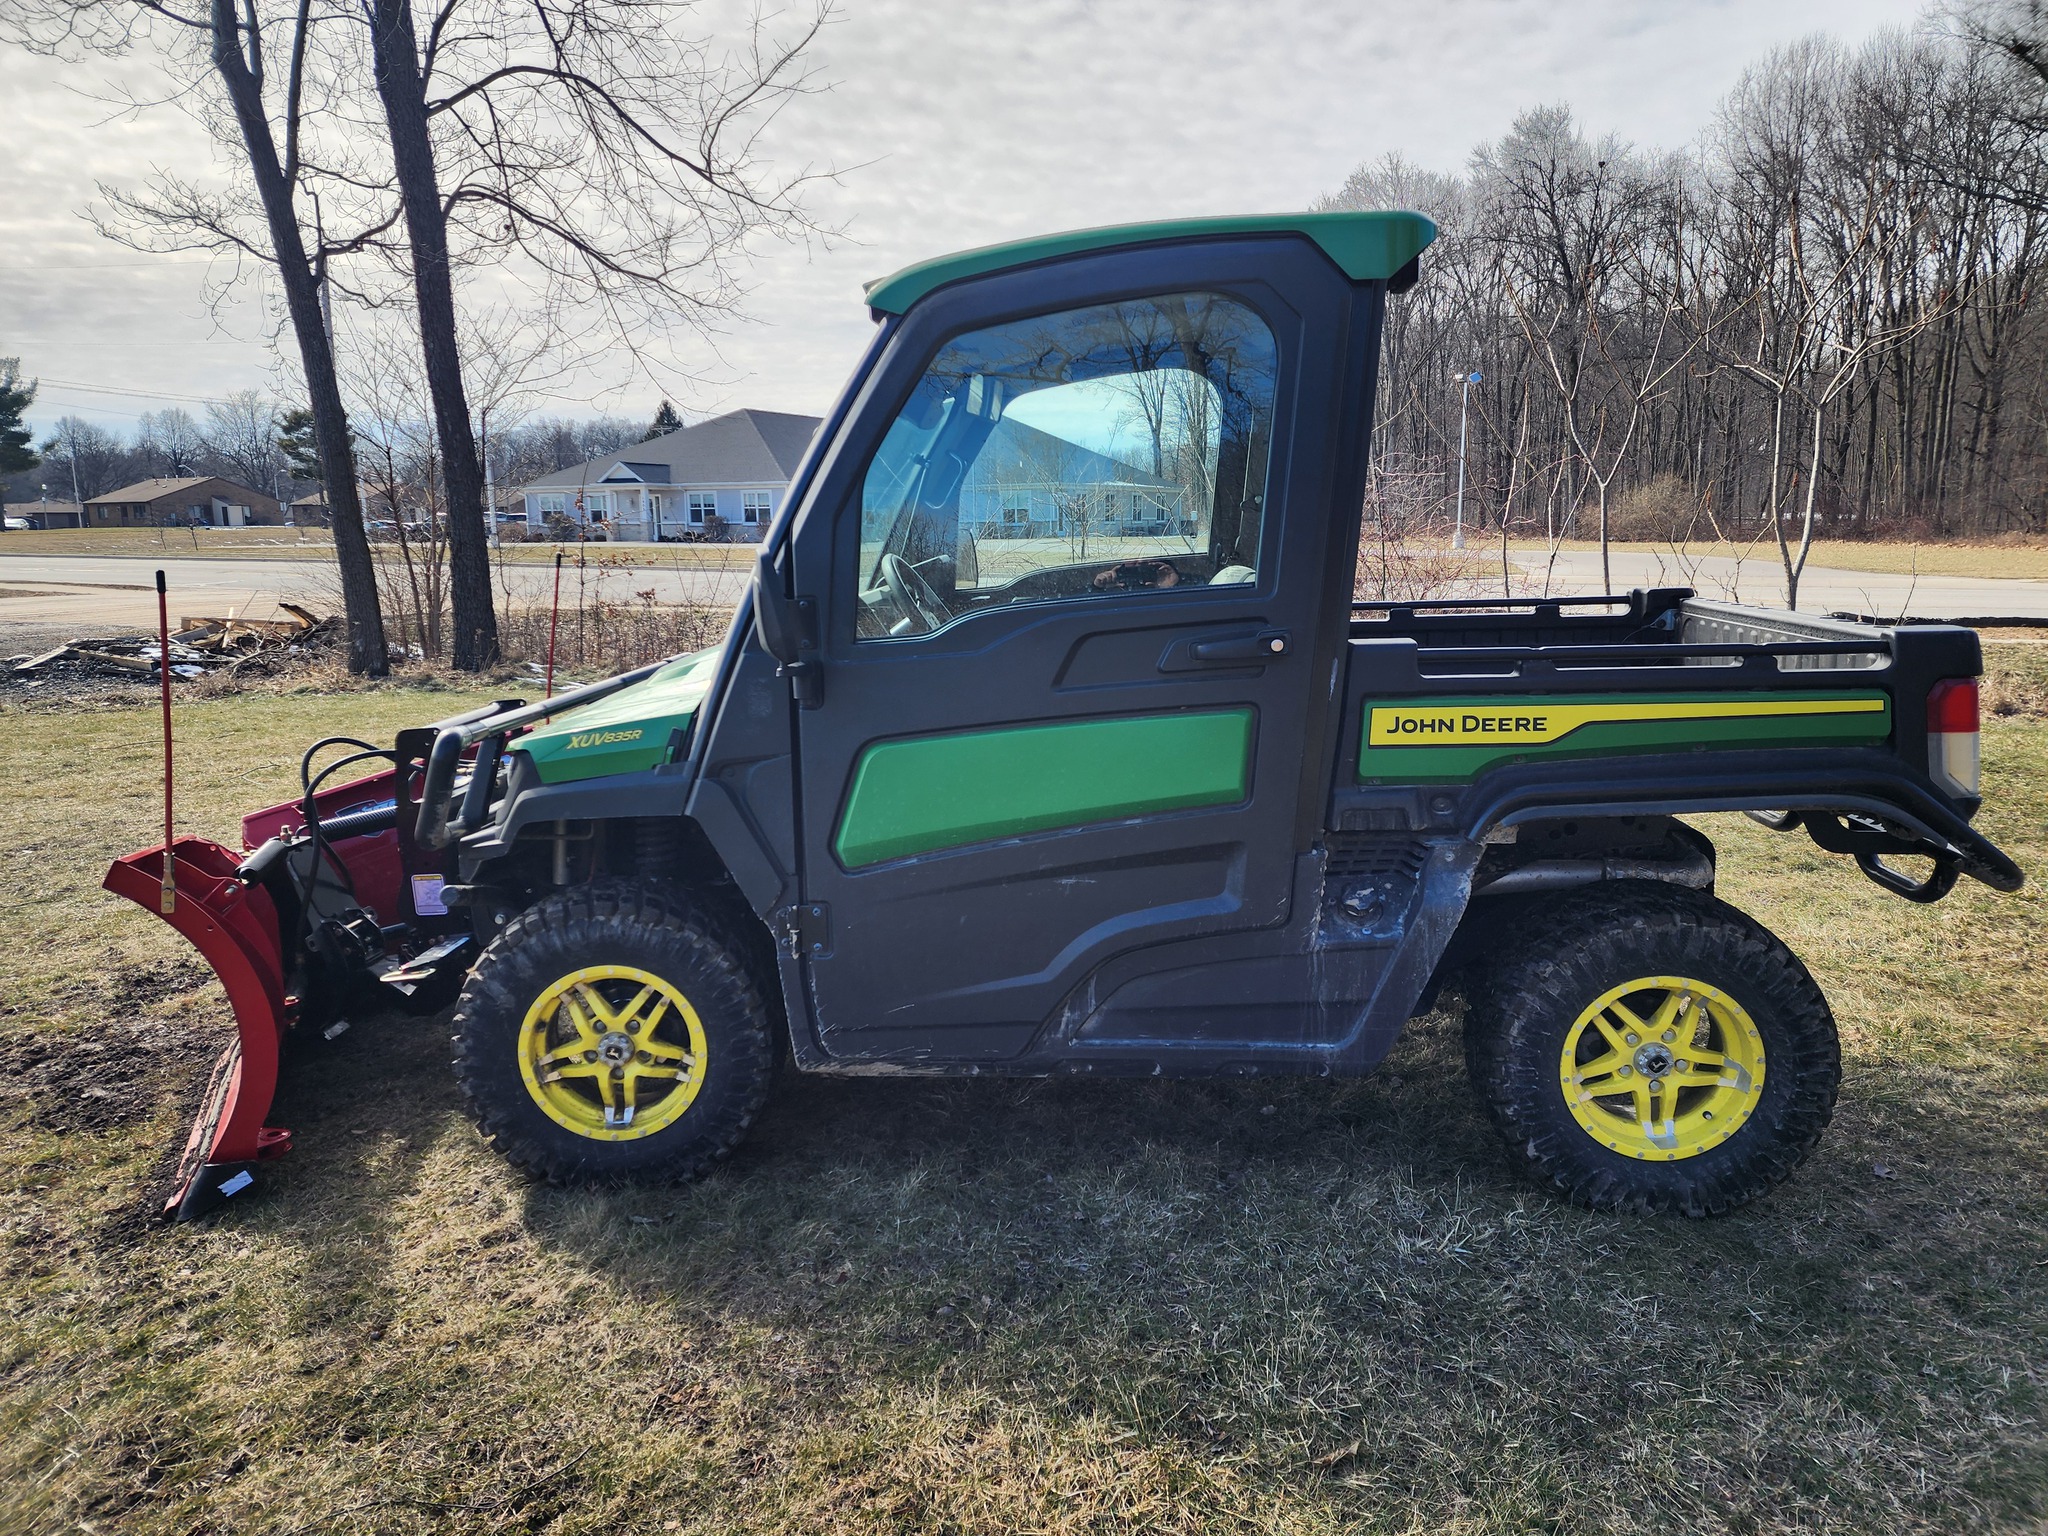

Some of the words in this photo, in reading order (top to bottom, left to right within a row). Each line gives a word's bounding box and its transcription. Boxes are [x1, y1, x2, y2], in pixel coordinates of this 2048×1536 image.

[1386, 716, 1454, 734] JOHN
[1462, 715, 1547, 732] DEERE
[566, 729, 643, 750] XUV835R
